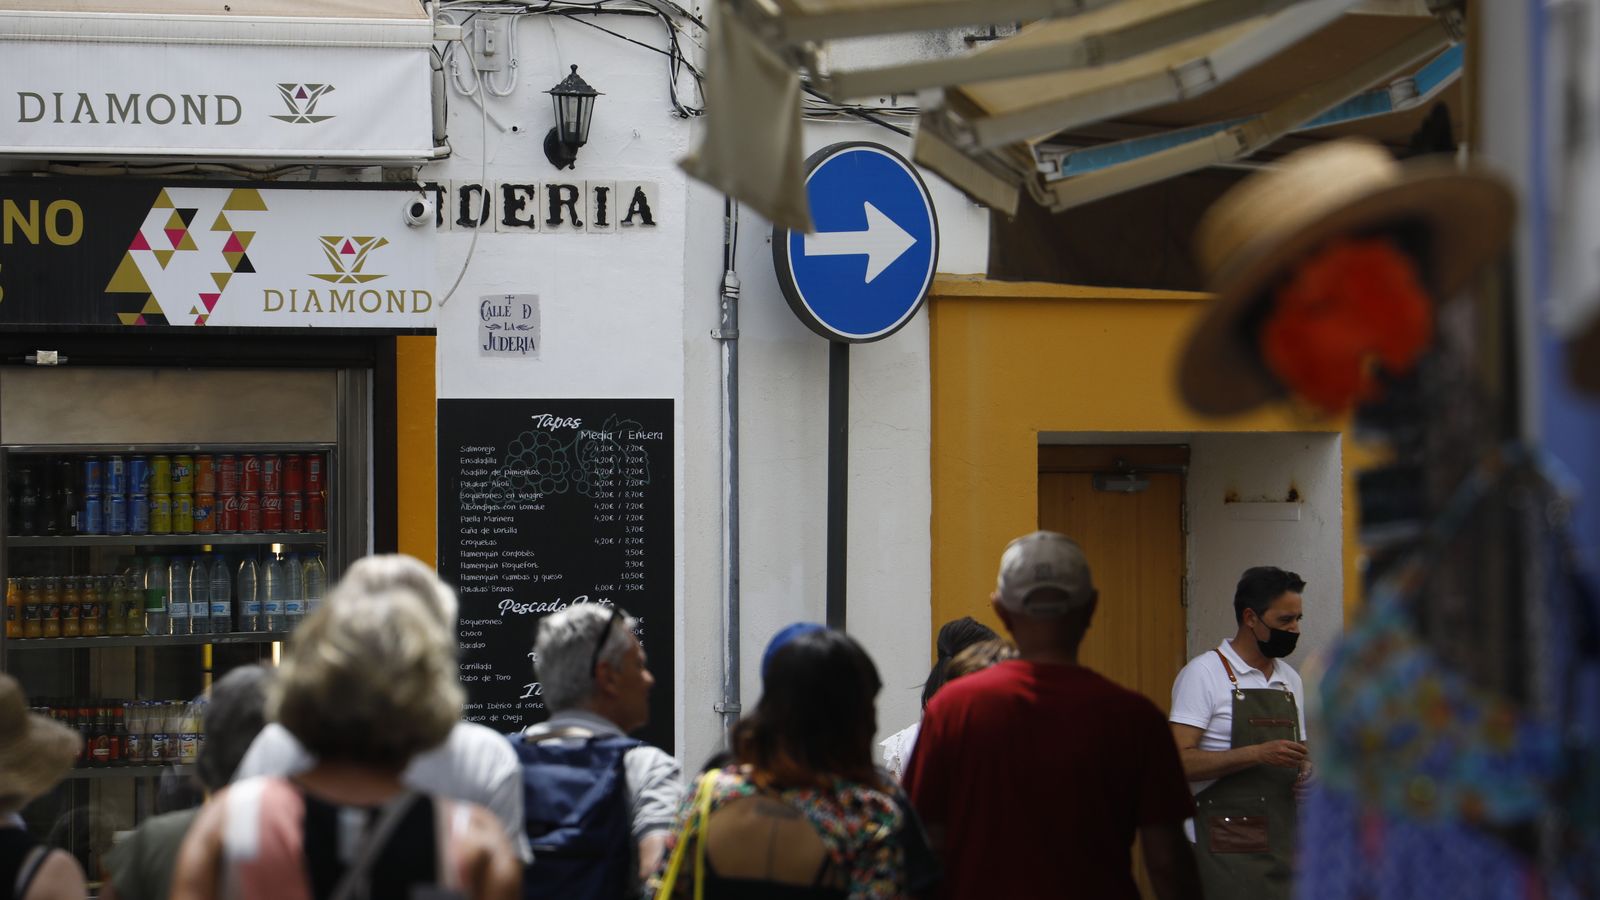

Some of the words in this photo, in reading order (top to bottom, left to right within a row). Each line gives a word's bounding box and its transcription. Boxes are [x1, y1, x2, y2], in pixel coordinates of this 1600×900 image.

[17, 91, 242, 126] DIAMOND
[436, 183, 657, 229] DERIA
[3, 199, 84, 246] NO
[262, 288, 433, 314] DIAMOND
[532, 413, 582, 431] Tapas
[580, 431, 612, 440] Media
[628, 431, 663, 440] Entera
[460, 445, 495, 454] Salmorejo
[460, 468, 488, 476] Asadillo
[505, 468, 539, 477] pimientos
[460, 480, 488, 488] Patatas
[460, 492, 502, 501] Boquerones
[519, 492, 544, 501] vinagre
[460, 515, 480, 523] Paella
[484, 515, 514, 523] Marinera
[480, 527, 490, 535] de
[460, 539, 497, 547] Croquetas
[501, 561, 539, 571] Roquefort
[502, 573, 530, 581] Gambas
[534, 574, 539, 582] y
[541, 573, 563, 582] queso
[460, 585, 489, 593] Patatas
[460, 618, 502, 627] Boquerones
[460, 641, 486, 649] Bacalao
[460, 662, 492, 670] Carrillada
[482, 674, 491, 682] de
[502, 713, 523, 723] Oveja
